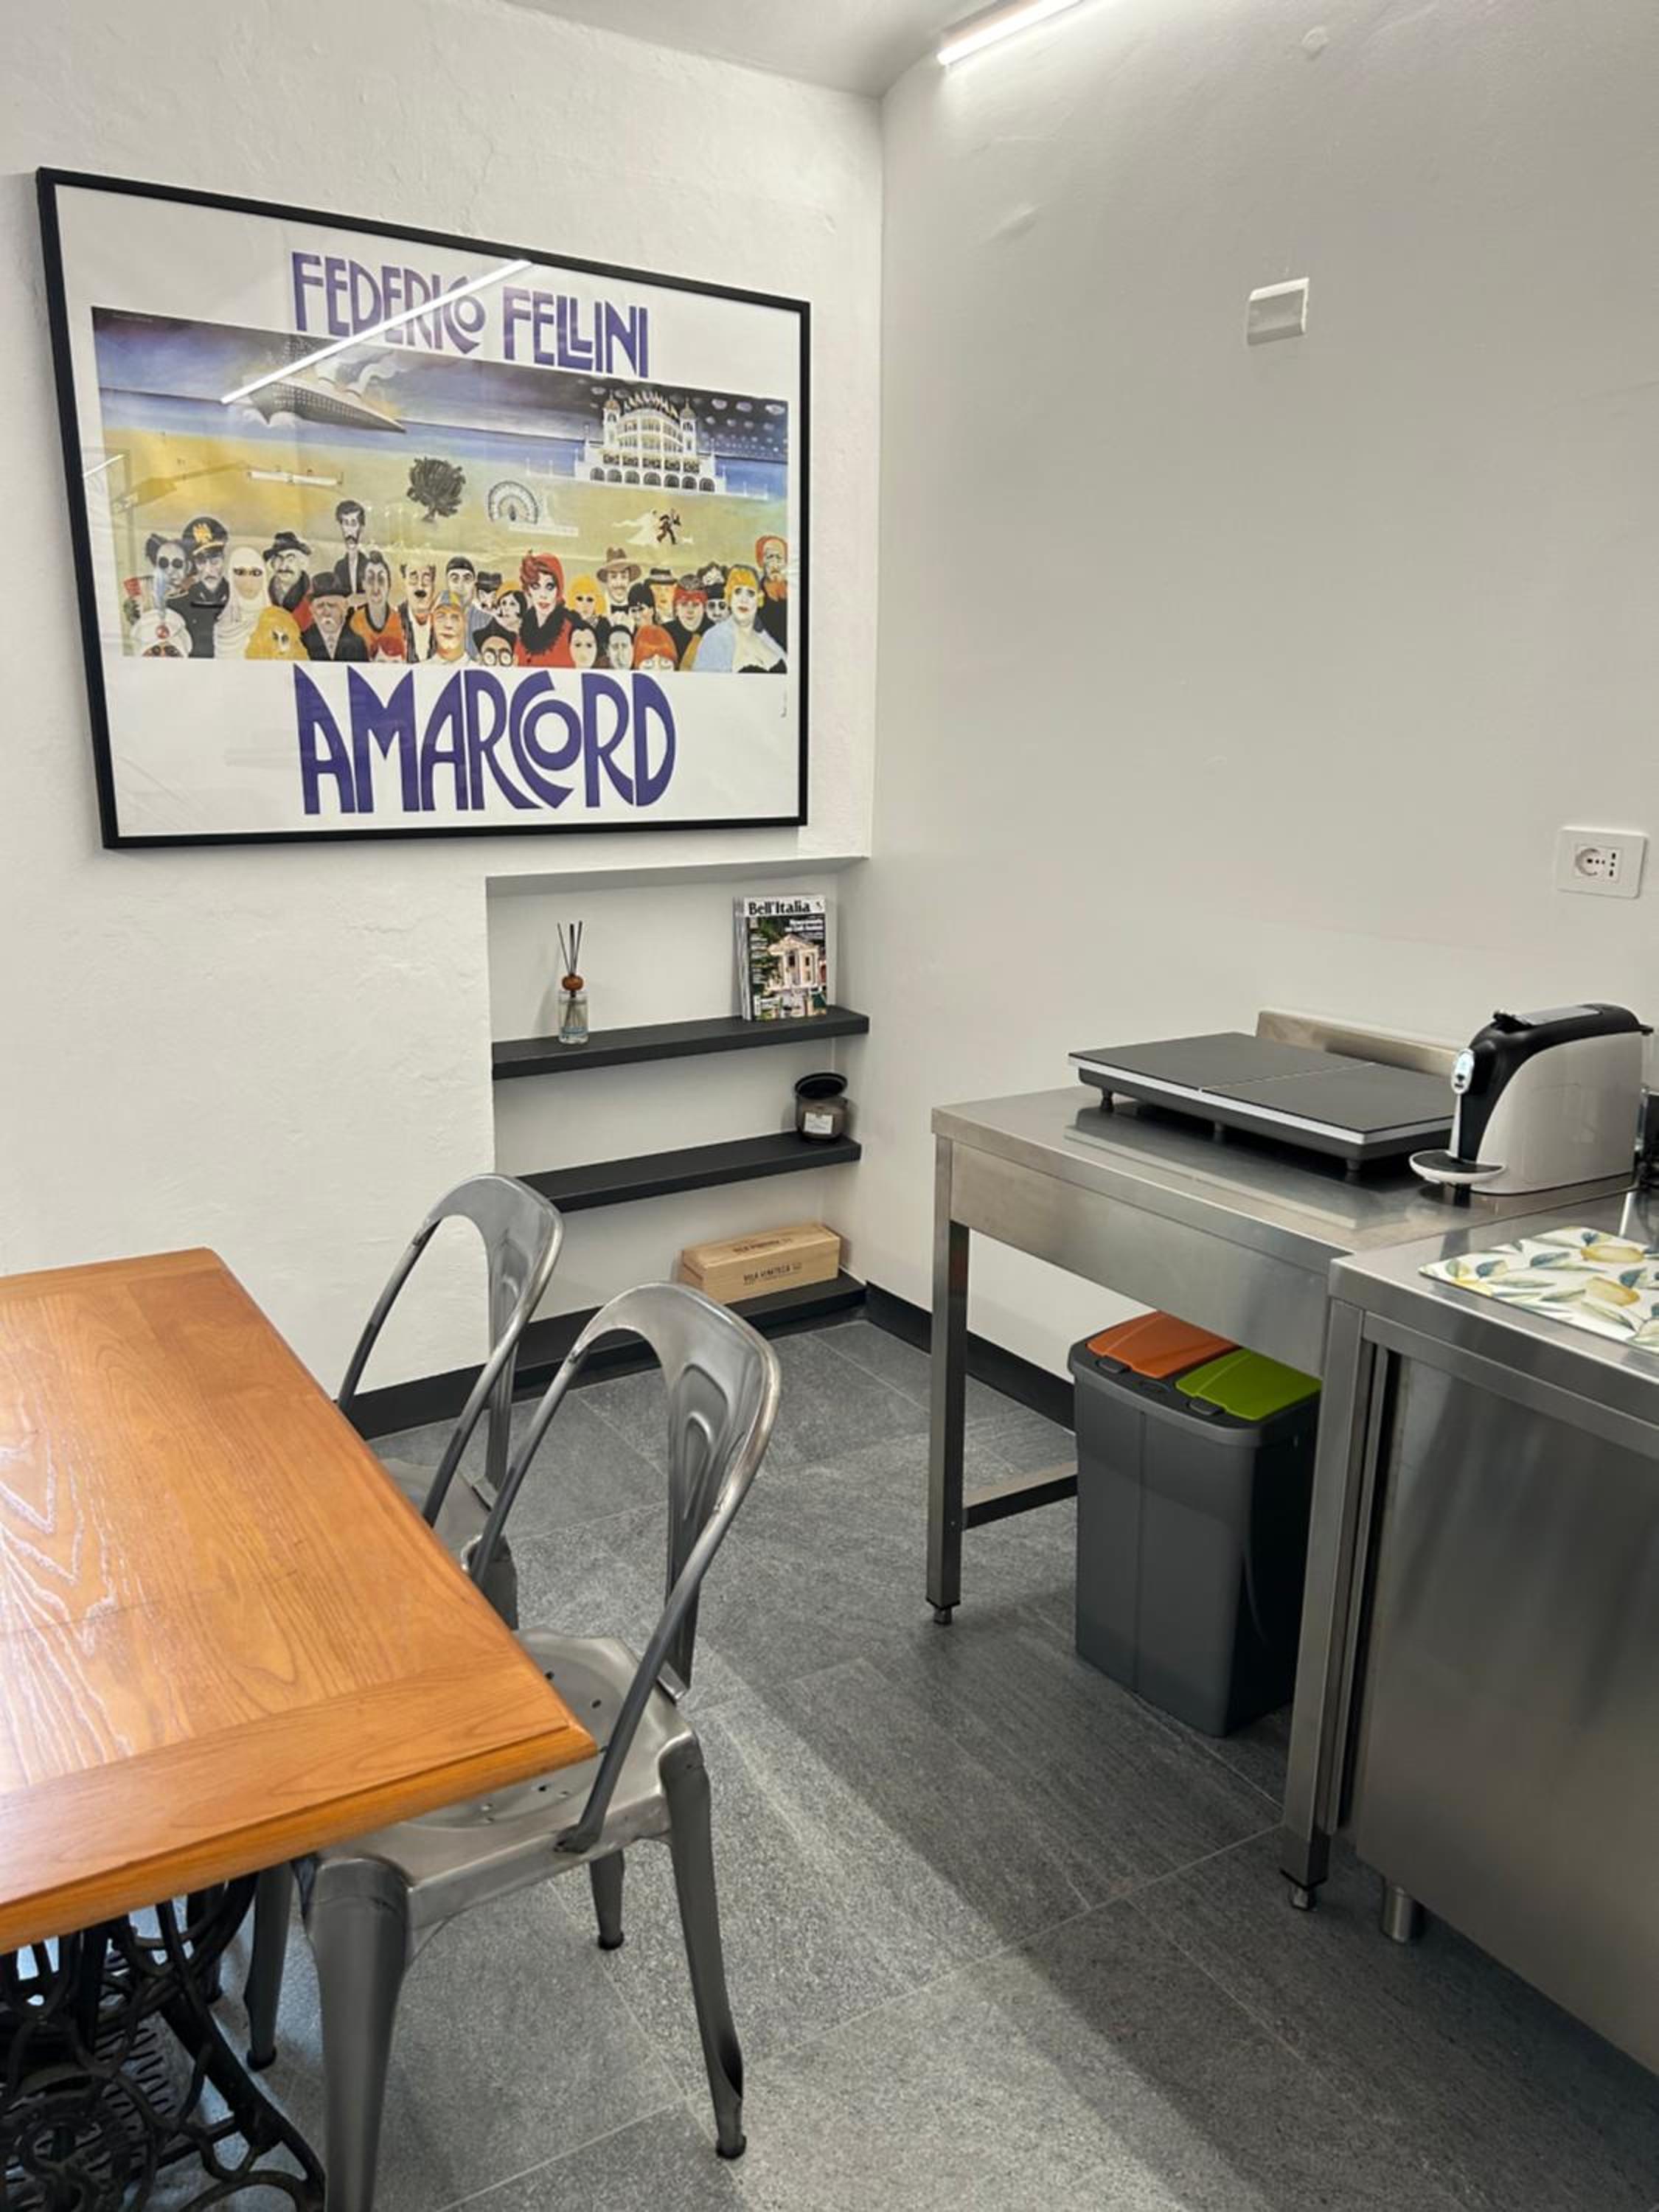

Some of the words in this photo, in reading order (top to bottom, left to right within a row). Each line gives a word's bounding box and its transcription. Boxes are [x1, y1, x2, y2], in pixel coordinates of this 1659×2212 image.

[292, 251, 487, 355] FEDERICO
[503, 286, 649, 379] FELLINI
[293, 664, 676, 815] AMARCORD
[748, 900, 810, 915] Bell'Italia
